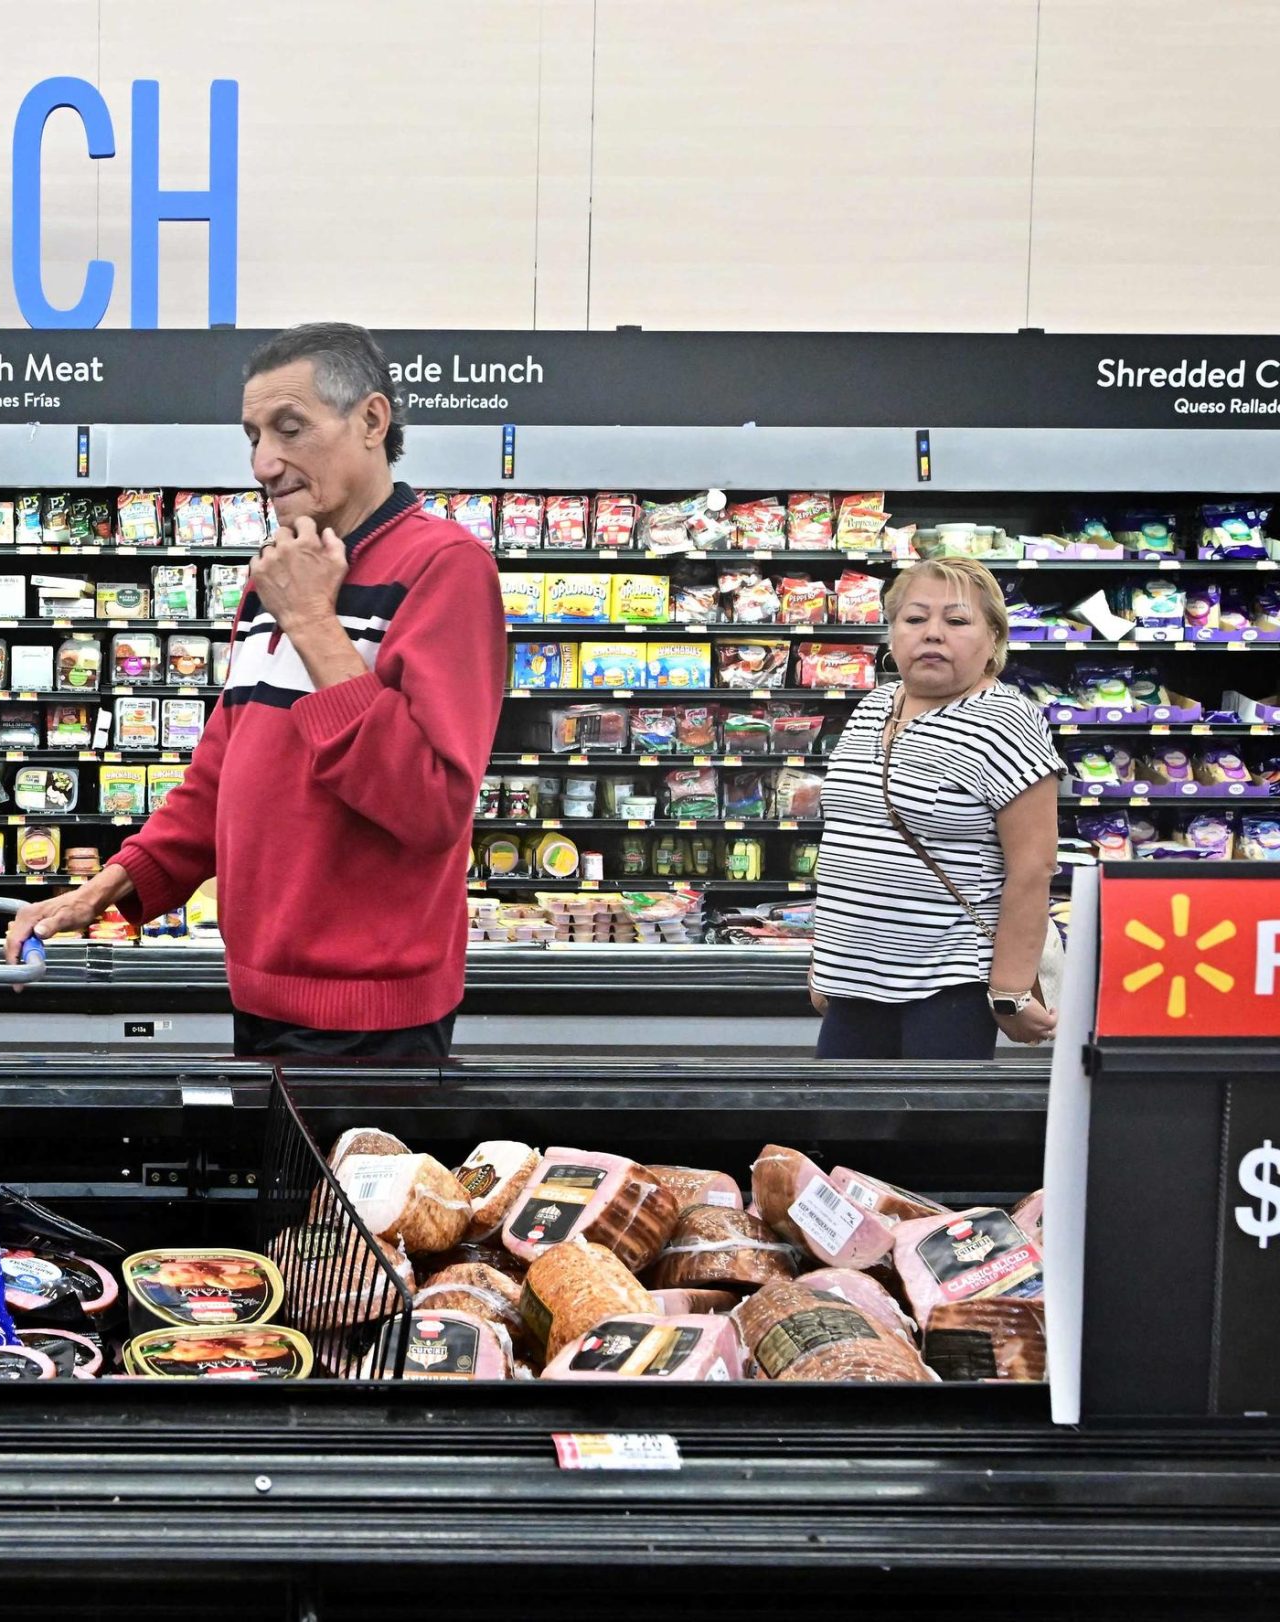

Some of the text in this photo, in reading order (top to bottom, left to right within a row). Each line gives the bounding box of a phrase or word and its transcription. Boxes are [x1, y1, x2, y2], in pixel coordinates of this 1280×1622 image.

[24, 353, 104, 382] Meat
[453, 354, 544, 383] Lunch
[1096, 358, 1246, 388] Shredded
[24, 392, 61, 408] Frías
[408, 393, 509, 409] Prefabricado
[1174, 398, 1225, 414] Queso
[23, 496, 39, 509] P3
[50, 497, 65, 509] P3
[72, 501, 86, 515] P3
[93, 503, 108, 517] P3
[947, 1250, 1029, 1292] CLASSIC SLICED
